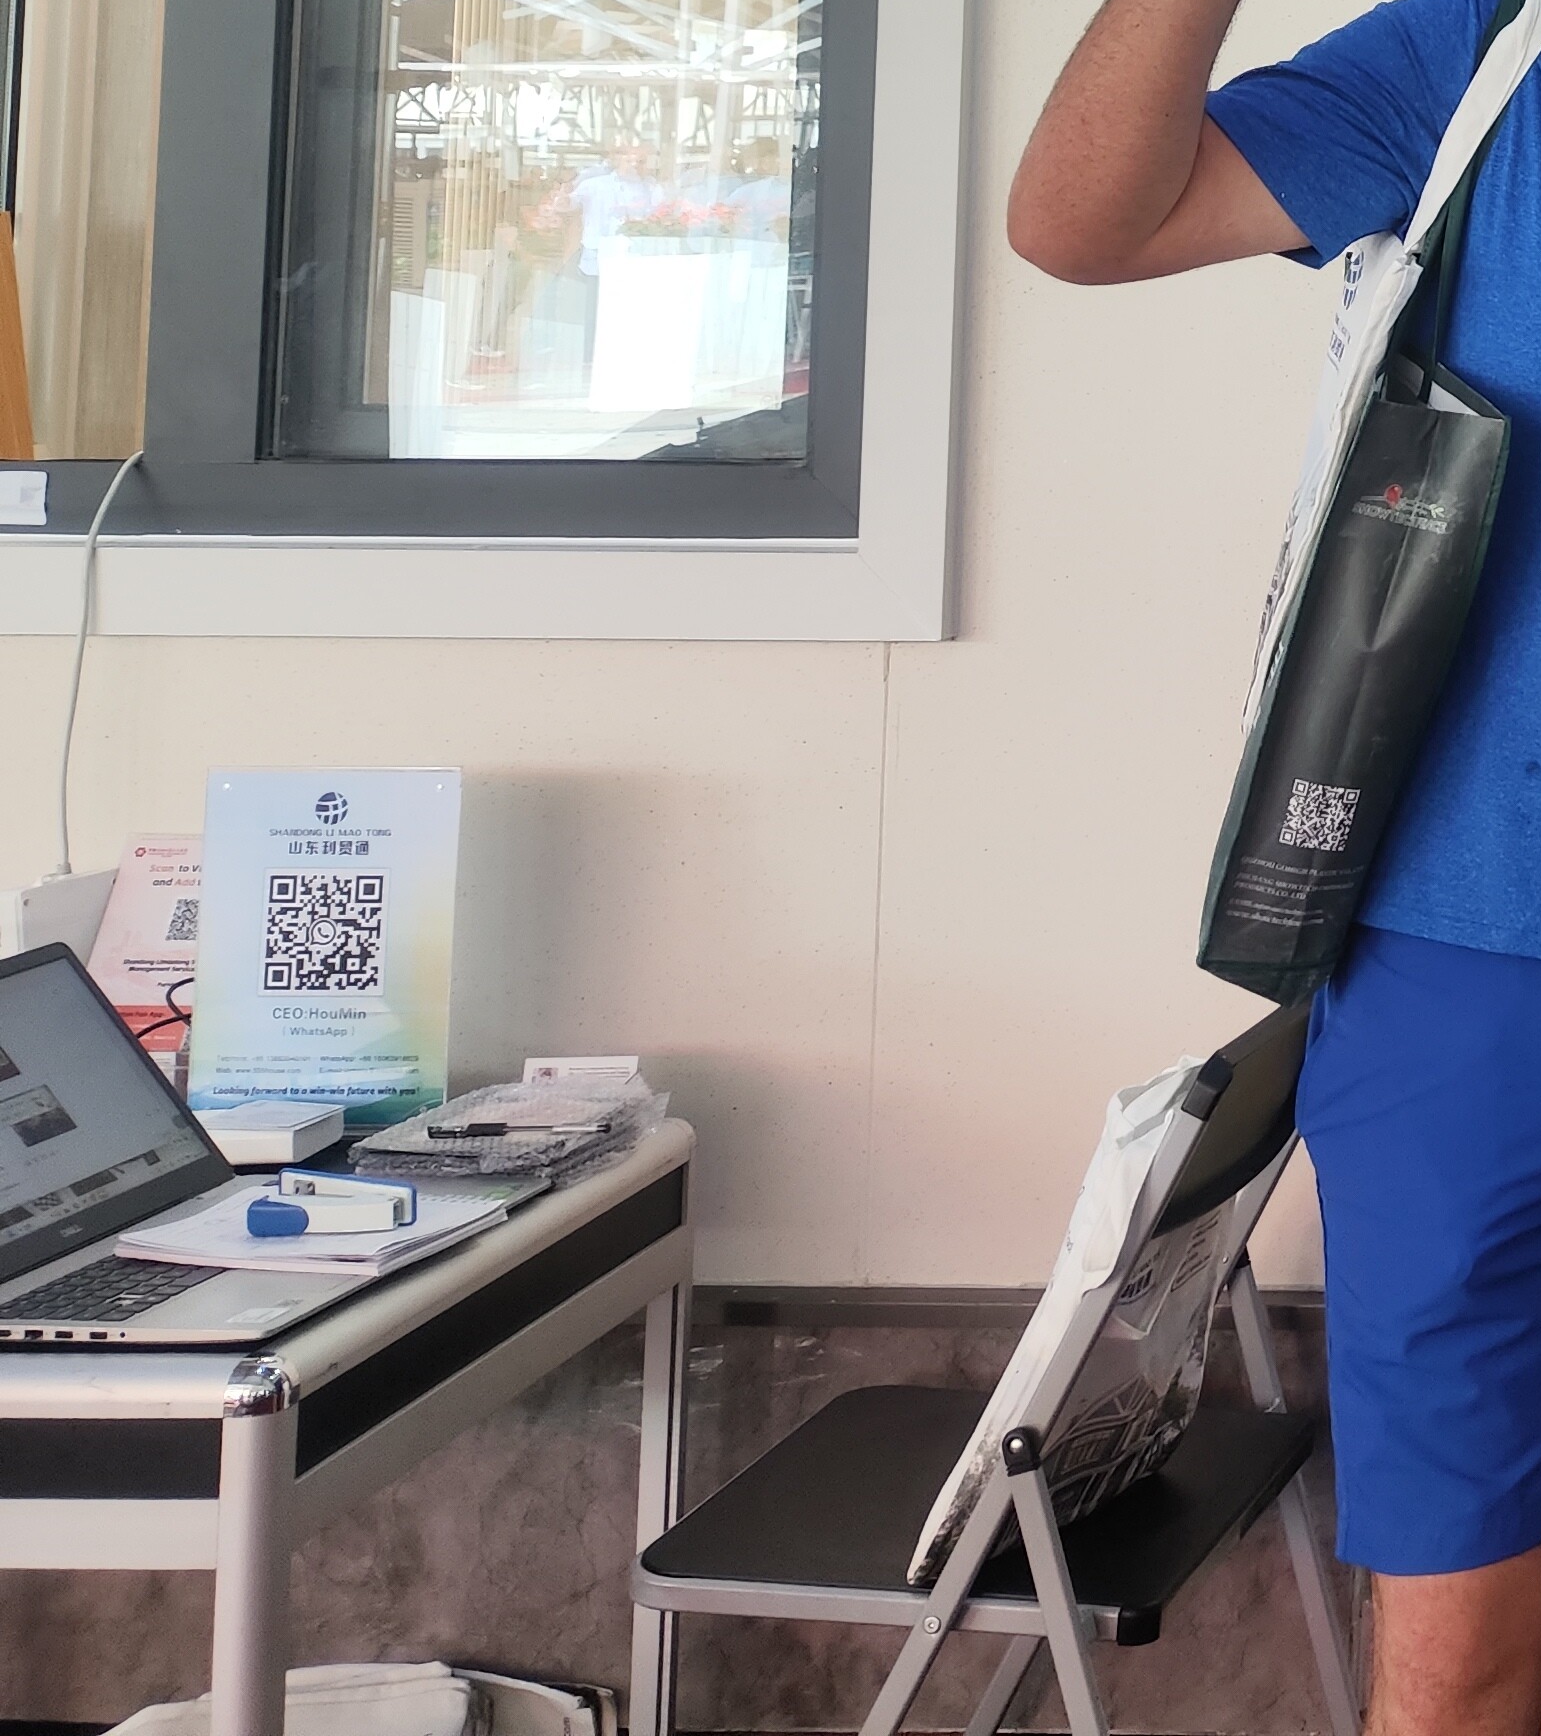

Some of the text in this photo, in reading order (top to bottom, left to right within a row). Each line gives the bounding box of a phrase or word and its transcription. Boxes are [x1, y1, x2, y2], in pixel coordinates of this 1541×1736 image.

[269, 828, 392, 837] SHANDONG LI MAO TONG
[178, 864, 189, 873] to
[152, 878, 173, 887] and
[271, 1007, 367, 1020] CEO:HouMin
[213, 1086, 250, 1097] Looking
[251, 1086, 288, 1097] forward
[290, 1086, 300, 1095] to
[309, 1086, 345, 1096] win-win
[347, 1086, 376, 1097] future
[377, 1086, 398, 1095] with
